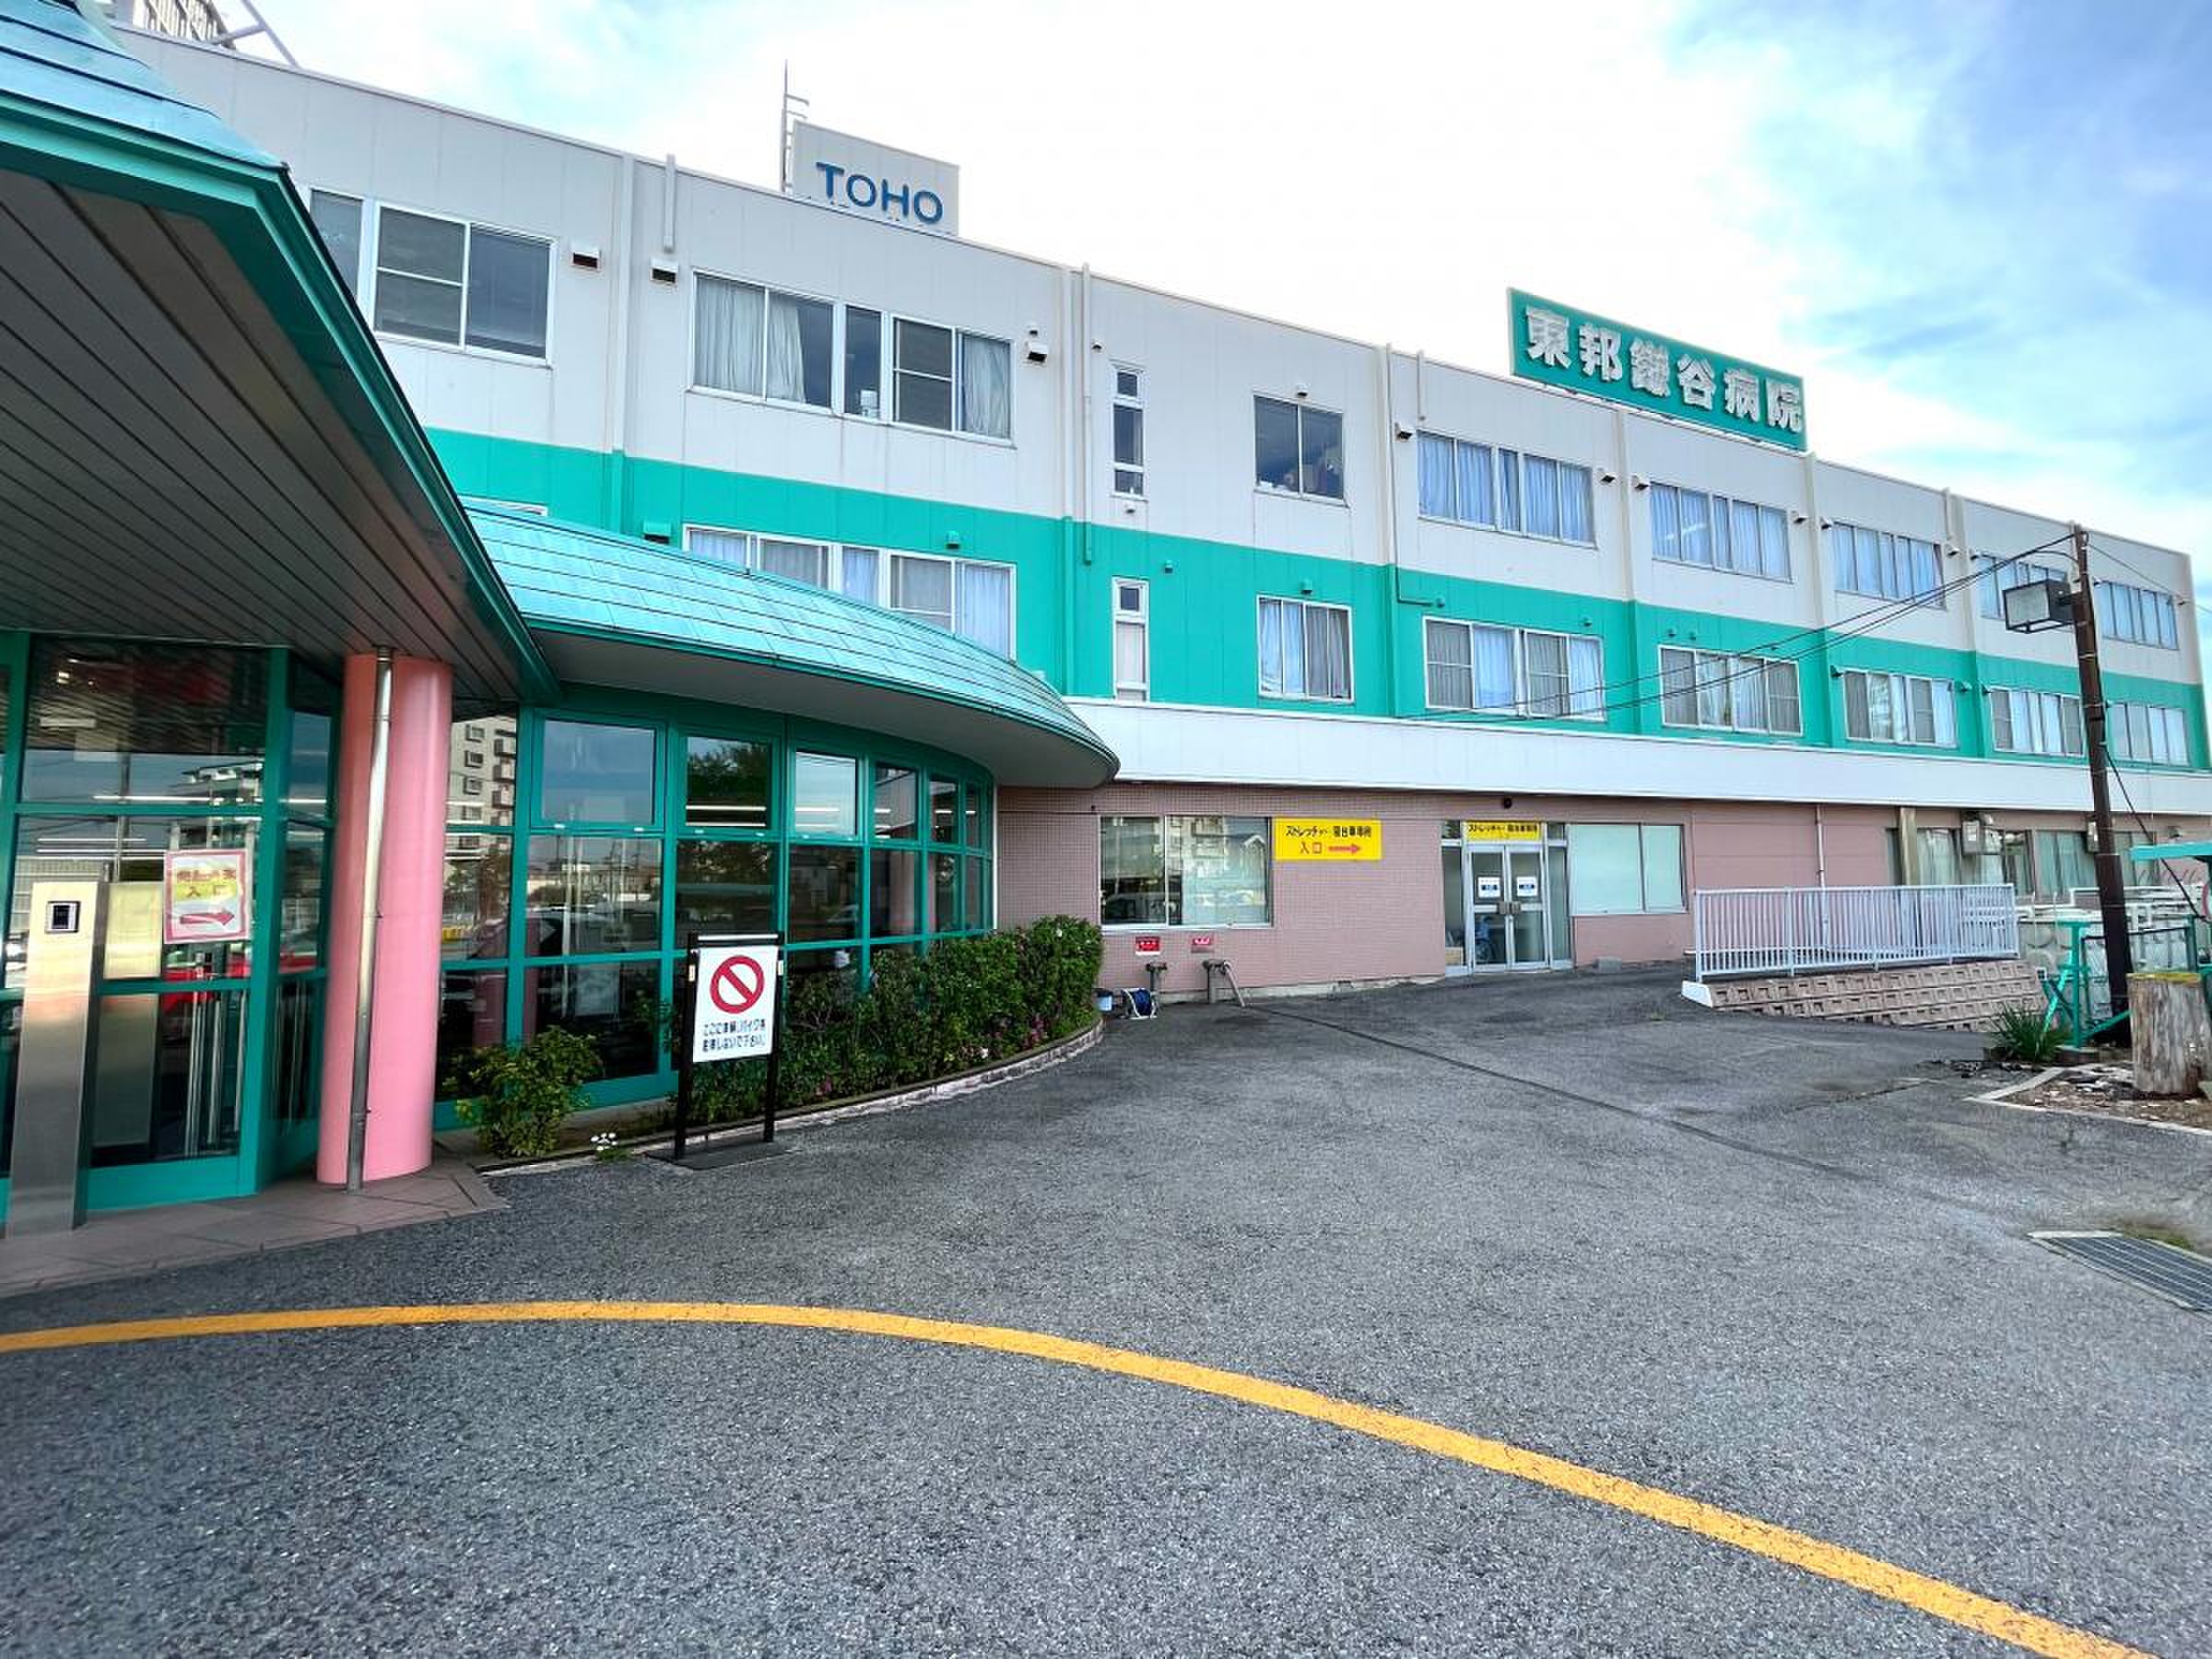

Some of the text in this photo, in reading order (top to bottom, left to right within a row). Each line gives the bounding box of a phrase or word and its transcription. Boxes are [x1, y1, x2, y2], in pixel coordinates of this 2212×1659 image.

[816, 161, 944, 224] TOHO
[1525, 304, 1803, 432] 東邦鎌谷病院
